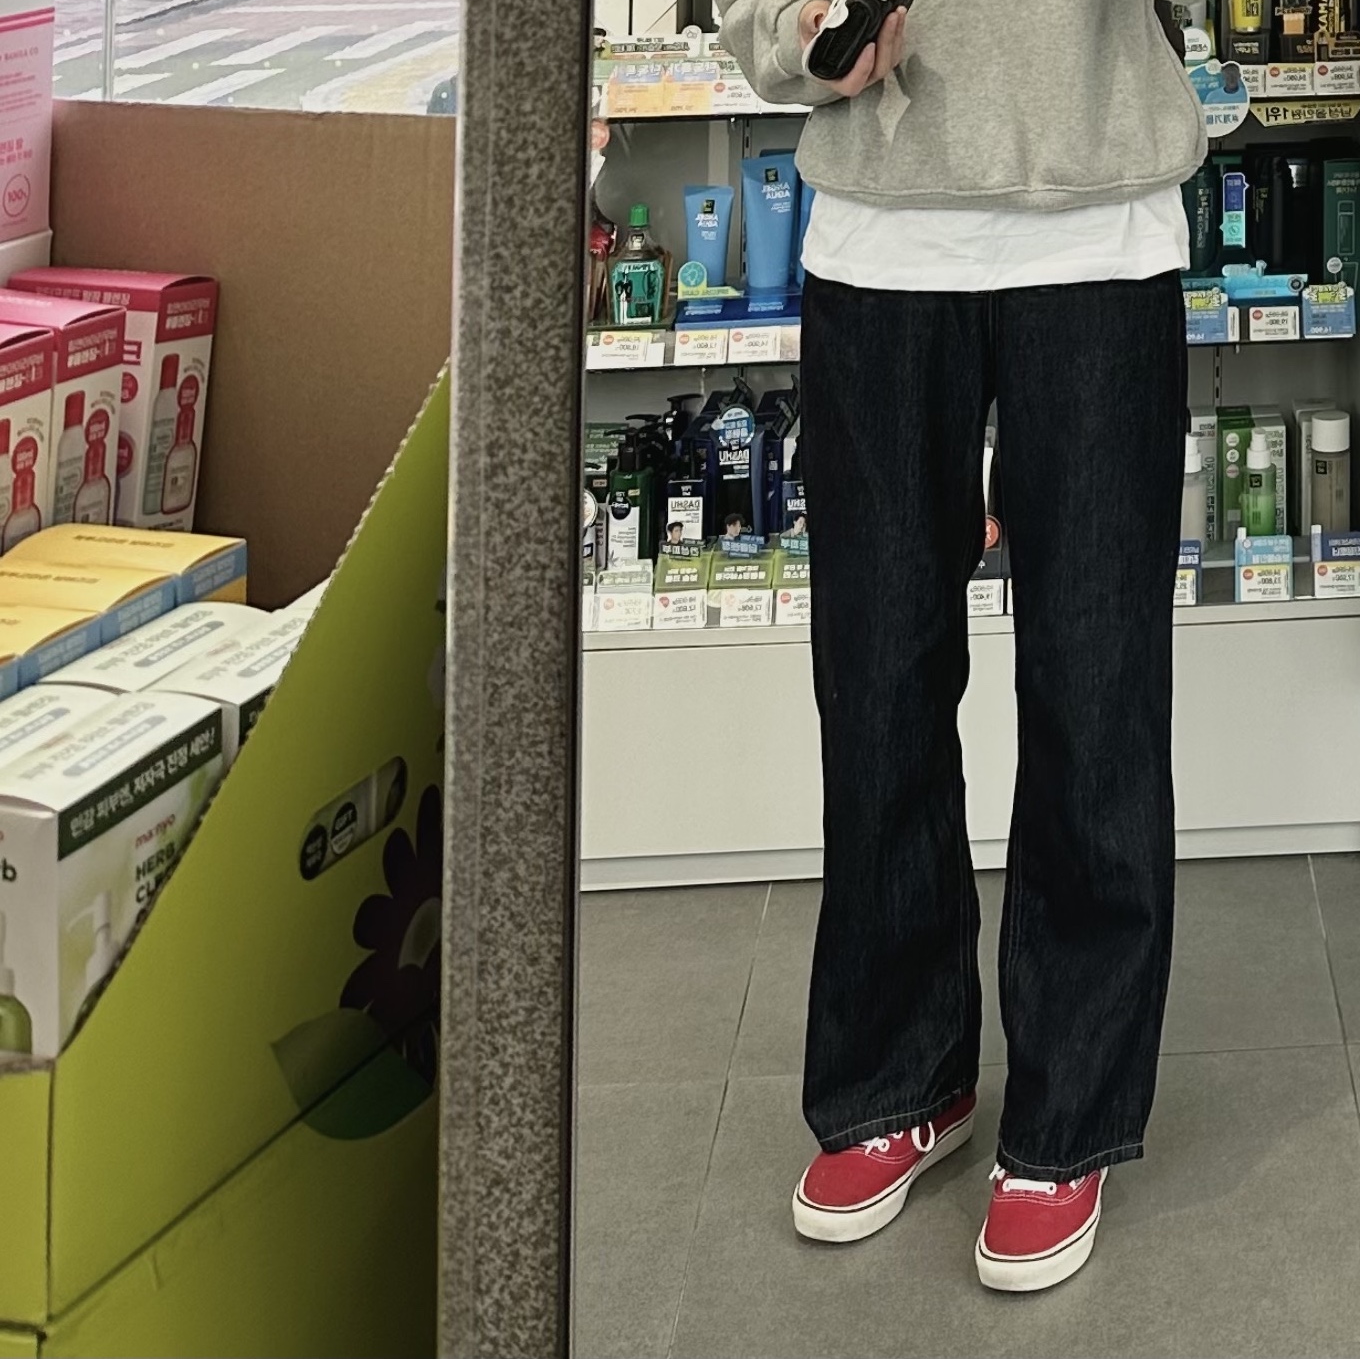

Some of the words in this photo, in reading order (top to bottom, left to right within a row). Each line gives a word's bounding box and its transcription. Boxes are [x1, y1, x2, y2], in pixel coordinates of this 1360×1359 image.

[167, 746, 190, 778] 진정
[189, 726, 217, 762] 세안!
[134, 844, 177, 882] HERB
